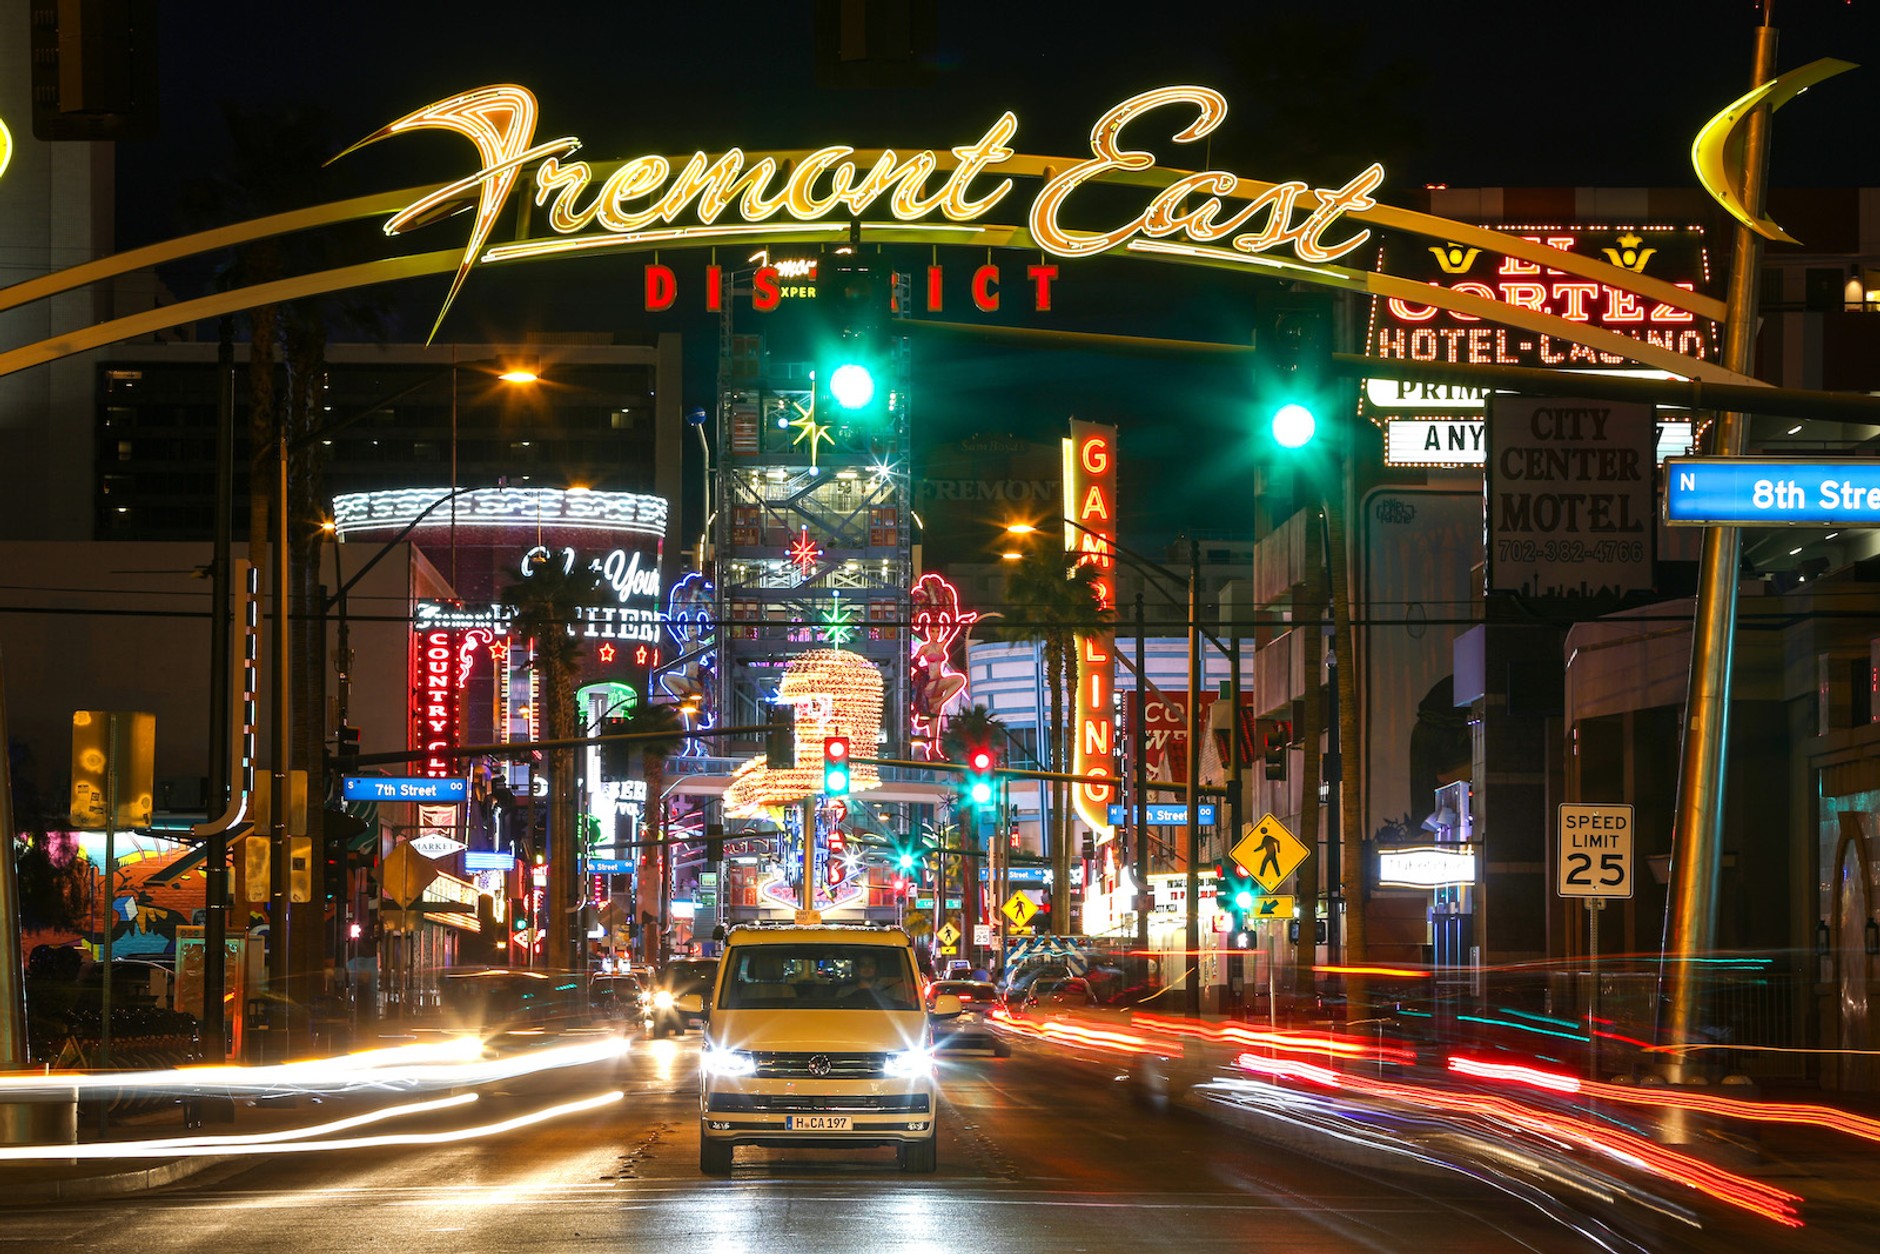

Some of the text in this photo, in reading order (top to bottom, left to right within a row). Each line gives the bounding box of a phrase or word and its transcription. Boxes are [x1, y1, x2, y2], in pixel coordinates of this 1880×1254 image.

[323, 84, 1386, 347] Fremont East
[645, 264, 1059, 312] DISICT
[1530, 407, 1611, 441] CITY
[1499, 446, 1642, 482] CENTER
[914, 479, 1060, 502] FREMON
[1680, 472, 1696, 492] N
[1752, 479, 1805, 510] 8th
[1497, 492, 1645, 533] MOTEL
[1498, 539, 1643, 564] 702-382-4766
[427, 632, 450, 732] COUNTRY
[348, 781, 354, 790] S
[375, 783, 396, 797] 7th
[399, 784, 438, 797] Street
[1156, 809, 1188, 821] Street
[1565, 814, 1627, 830] SPEED
[1571, 833, 1619, 849] LIMIT
[597, 863, 619, 871] Street
[1009, 871, 1029, 879] Street
[1566, 853, 1624, 886] 25
[975, 934, 988, 943] 25
[827, 1117, 847, 1128] 197
